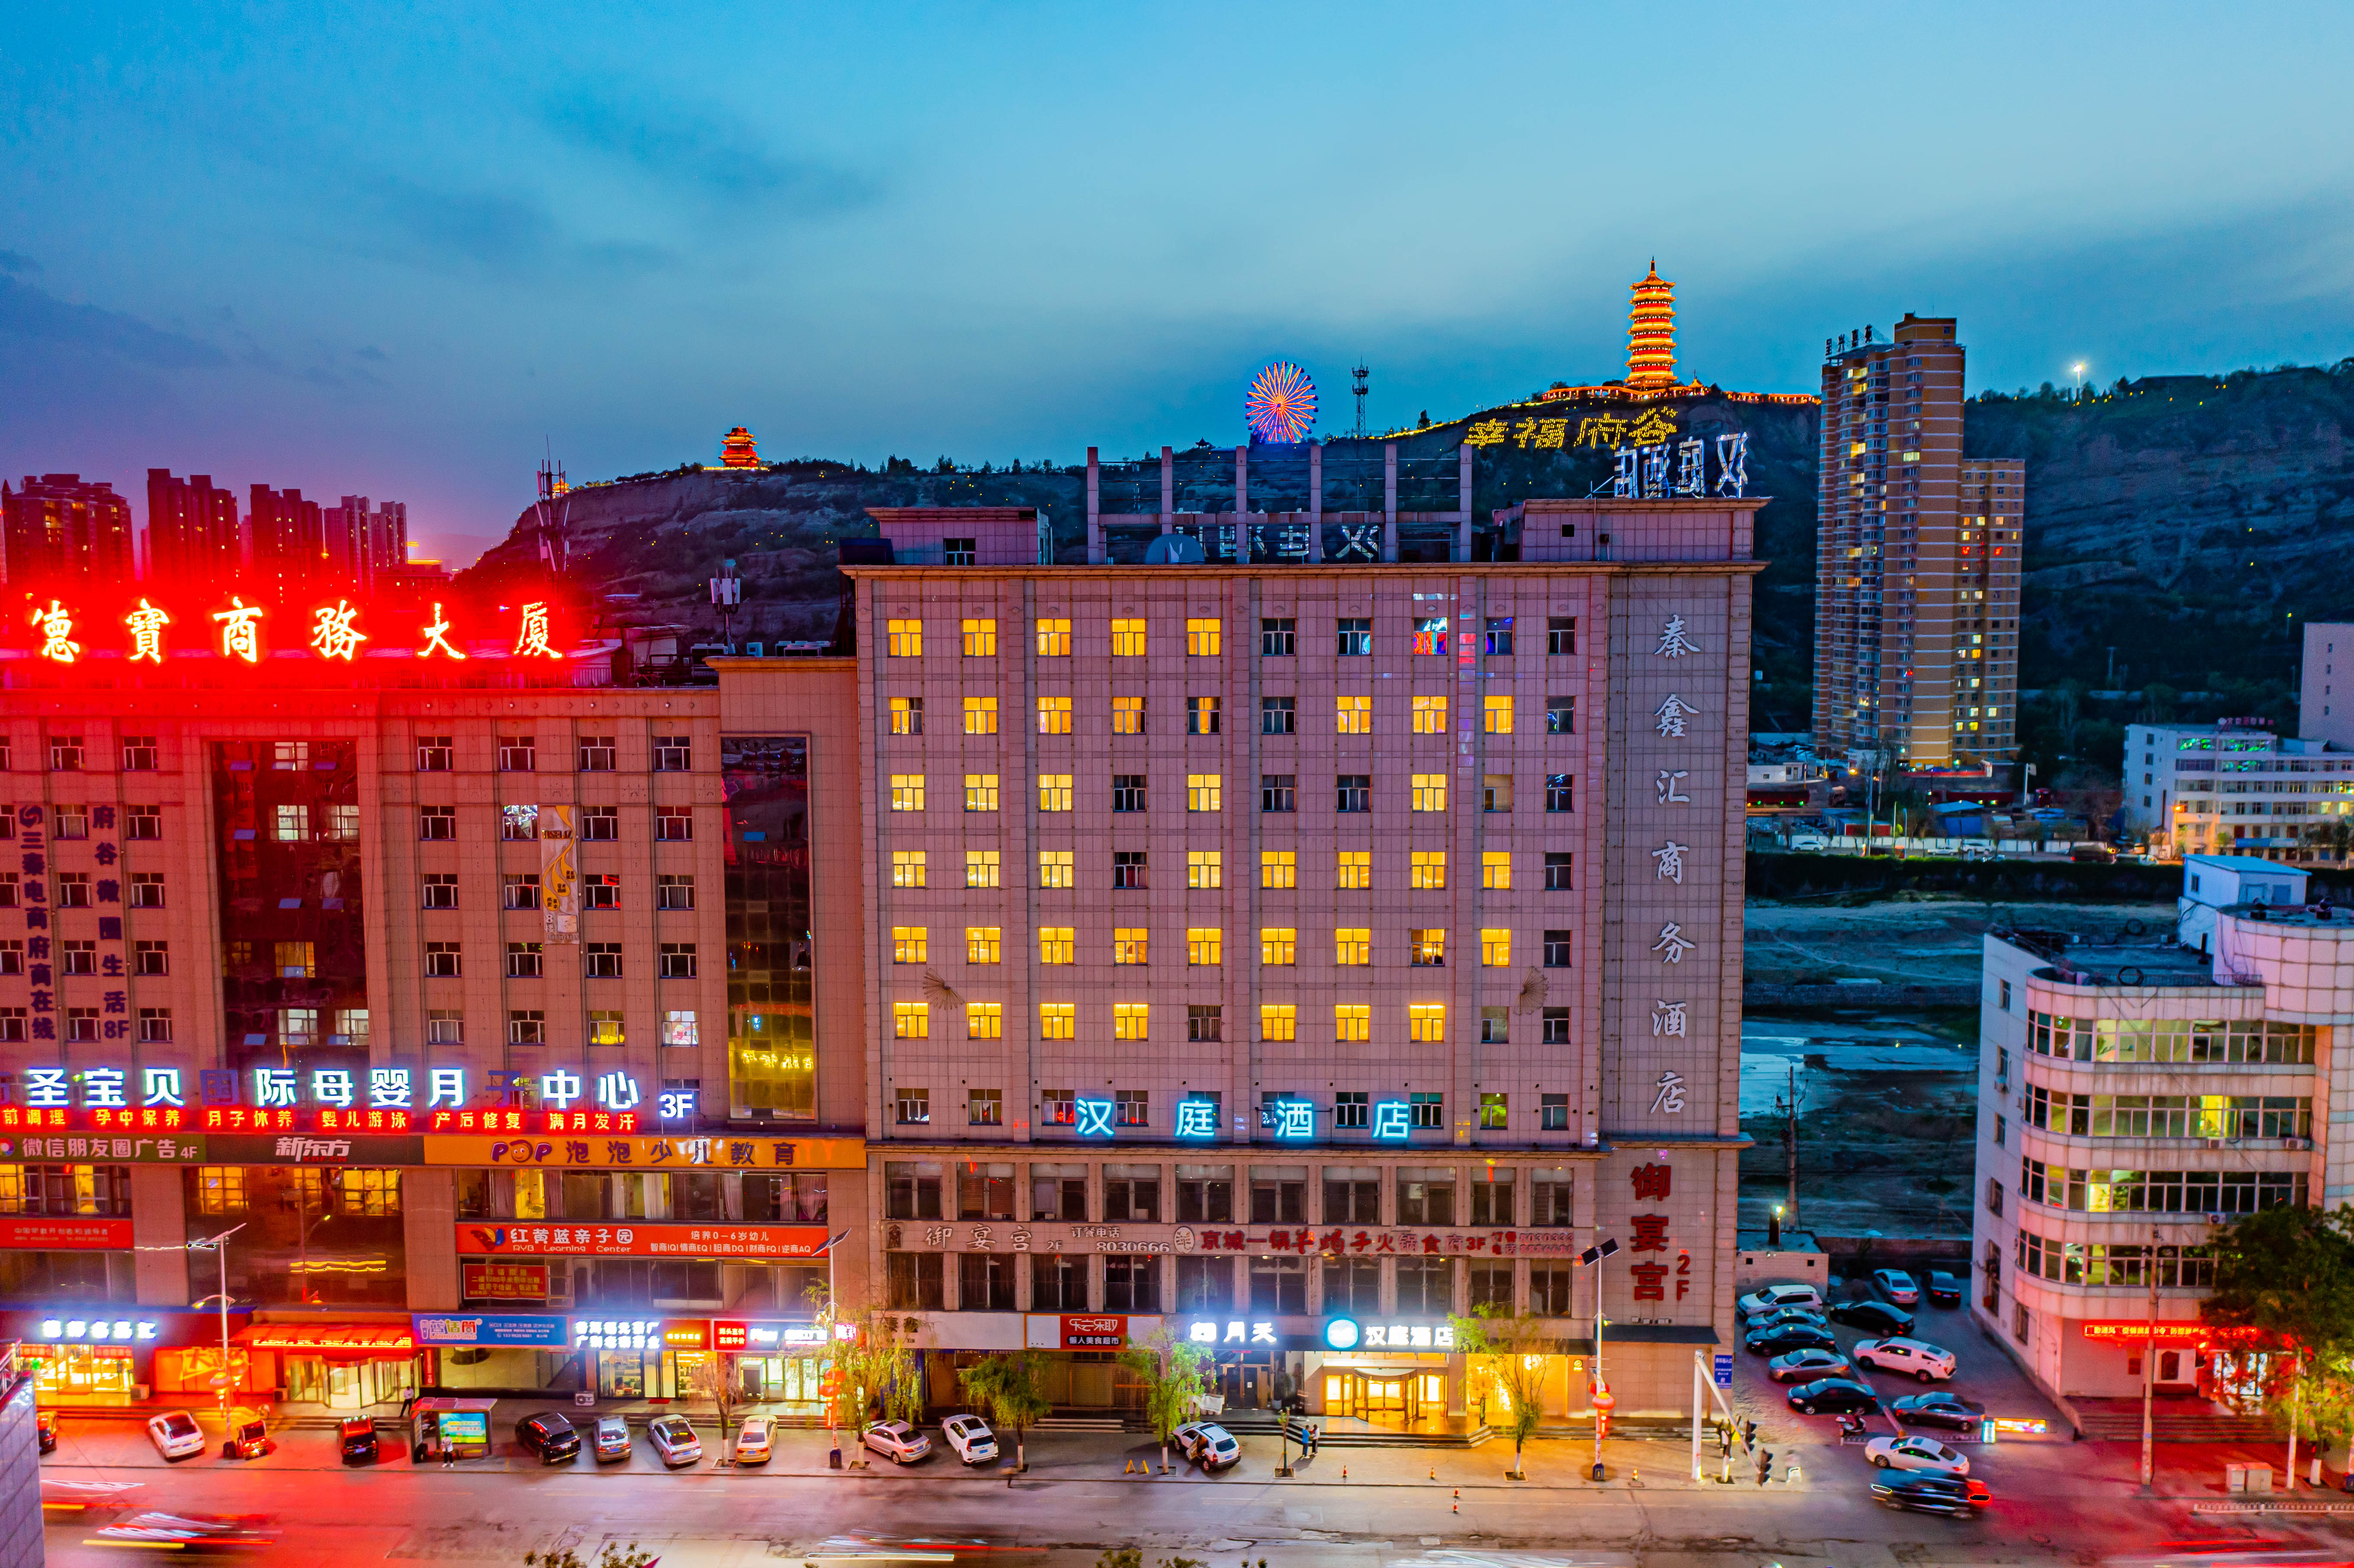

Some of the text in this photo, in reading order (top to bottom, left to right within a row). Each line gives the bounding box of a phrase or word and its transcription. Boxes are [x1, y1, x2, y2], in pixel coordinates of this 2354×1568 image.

[1463, 406, 1678, 450] 幸福府谷
[1650, 614, 1701, 1115] 秦鑫汇商务酒店
[104, 1020, 129, 1038] 8F
[0, 1067, 693, 1118] 圣宝贝国际母婴月子中心 3F
[3, 1109, 634, 1131] 前调理 孕中保养 月子休养 婴儿游泳 产后修复 满月发汗
[1076, 1098, 1410, 1139] 汉庭酒店
[23, 1137, 198, 1159] 微信朋友圈广告 4F
[276, 1137, 351, 1162] 新东方
[566, 1141, 797, 1166] 泡泡少儿教育
[510, 1228, 634, 1244] 红黄蓝亲子园
[925, 1223, 1064, 1252] 御宴宫 2F
[1071, 1226, 1120, 1238] 订餐电话
[1630, 1162, 1671, 1301] 御宴宫
[543, 1244, 586, 1253] Learning
[1096, 1241, 1170, 1253] 8030666
[1676, 1255, 1690, 1301] 2F
[1069, 1337, 1119, 1345] 懒人美食超市
[1365, 1325, 1454, 1347] 汉庭酒店
